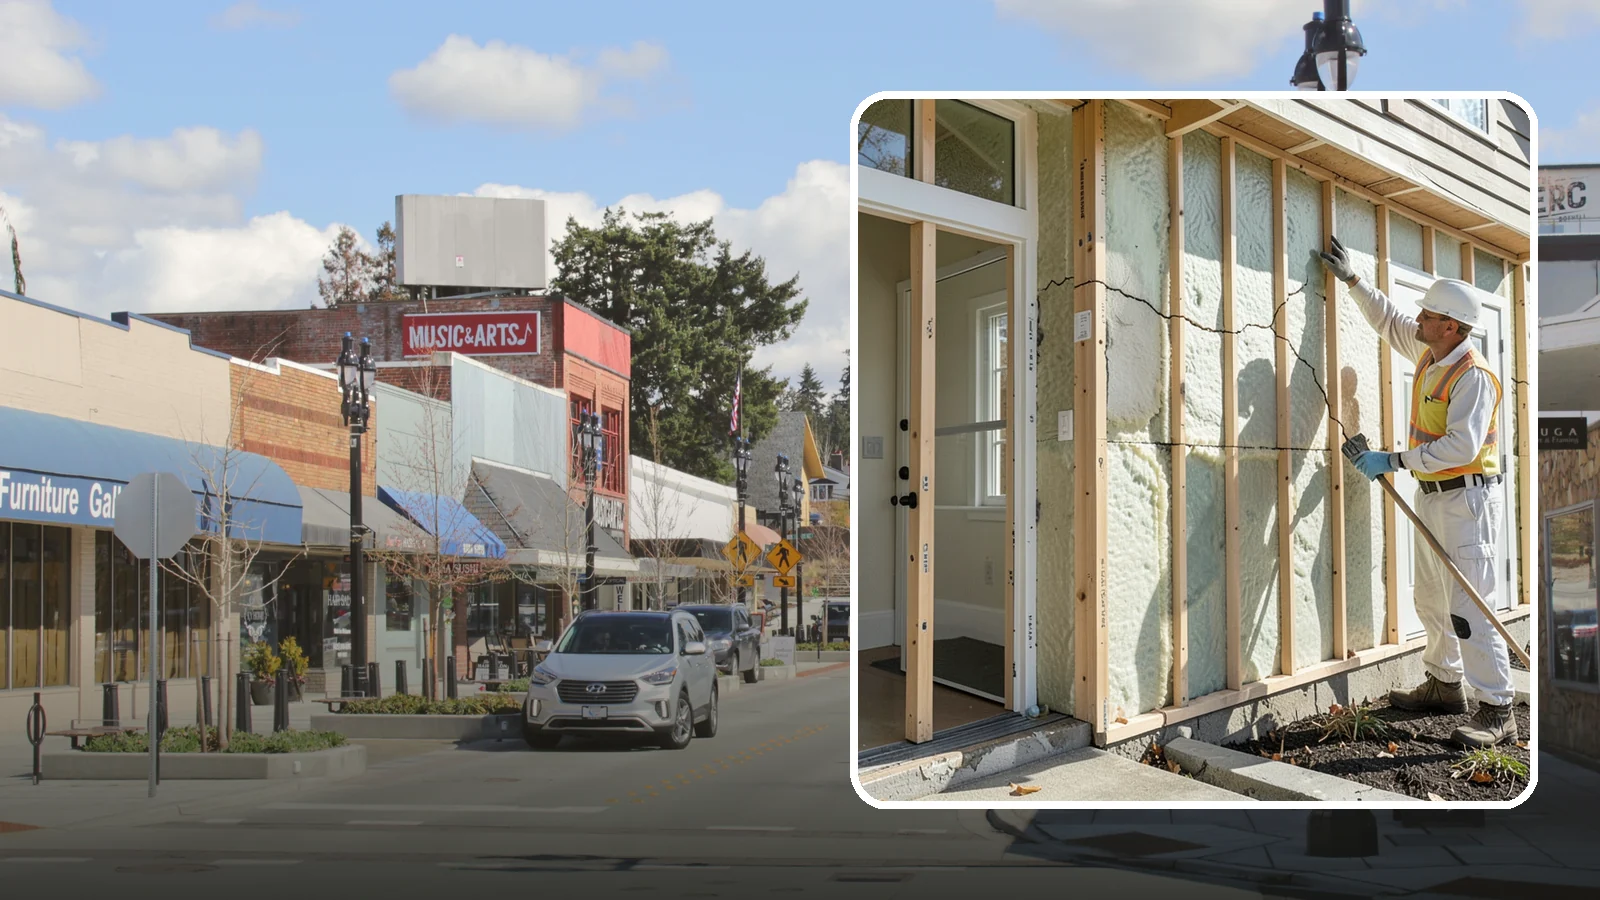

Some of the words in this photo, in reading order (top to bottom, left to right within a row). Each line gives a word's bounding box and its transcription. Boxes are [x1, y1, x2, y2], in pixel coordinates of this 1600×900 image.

[409, 323, 519, 348] MUSIC&ARTS
[0, 471, 79, 515] Furniture
[89, 482, 122, 519] Gal
[453, 563, 479, 574] SUSHI
